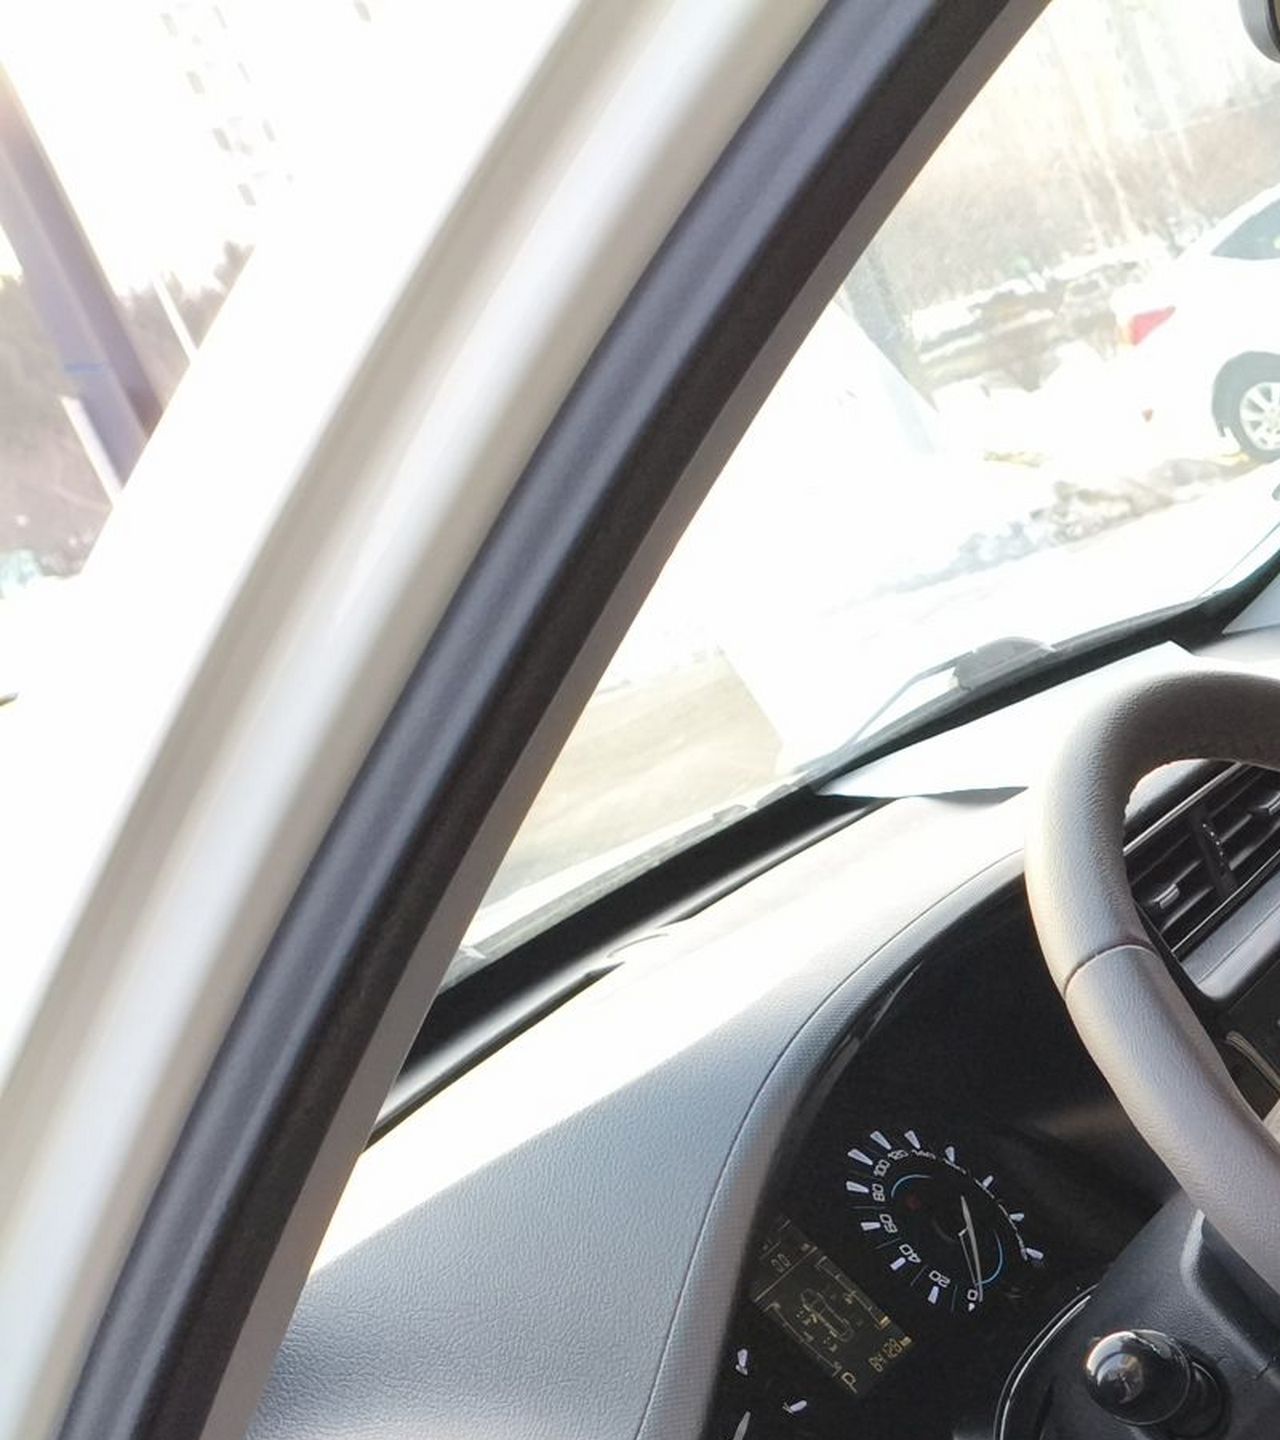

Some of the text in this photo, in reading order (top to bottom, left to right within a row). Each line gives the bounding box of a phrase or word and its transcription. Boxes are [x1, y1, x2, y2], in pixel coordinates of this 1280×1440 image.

[873, 1159, 891, 1177] 100
[872, 1183, 886, 1202] 80
[879, 1213, 898, 1234] 60
[899, 1243, 922, 1263] 40
[928, 1270, 951, 1288] 20
[841, 1372, 859, 1394] P
